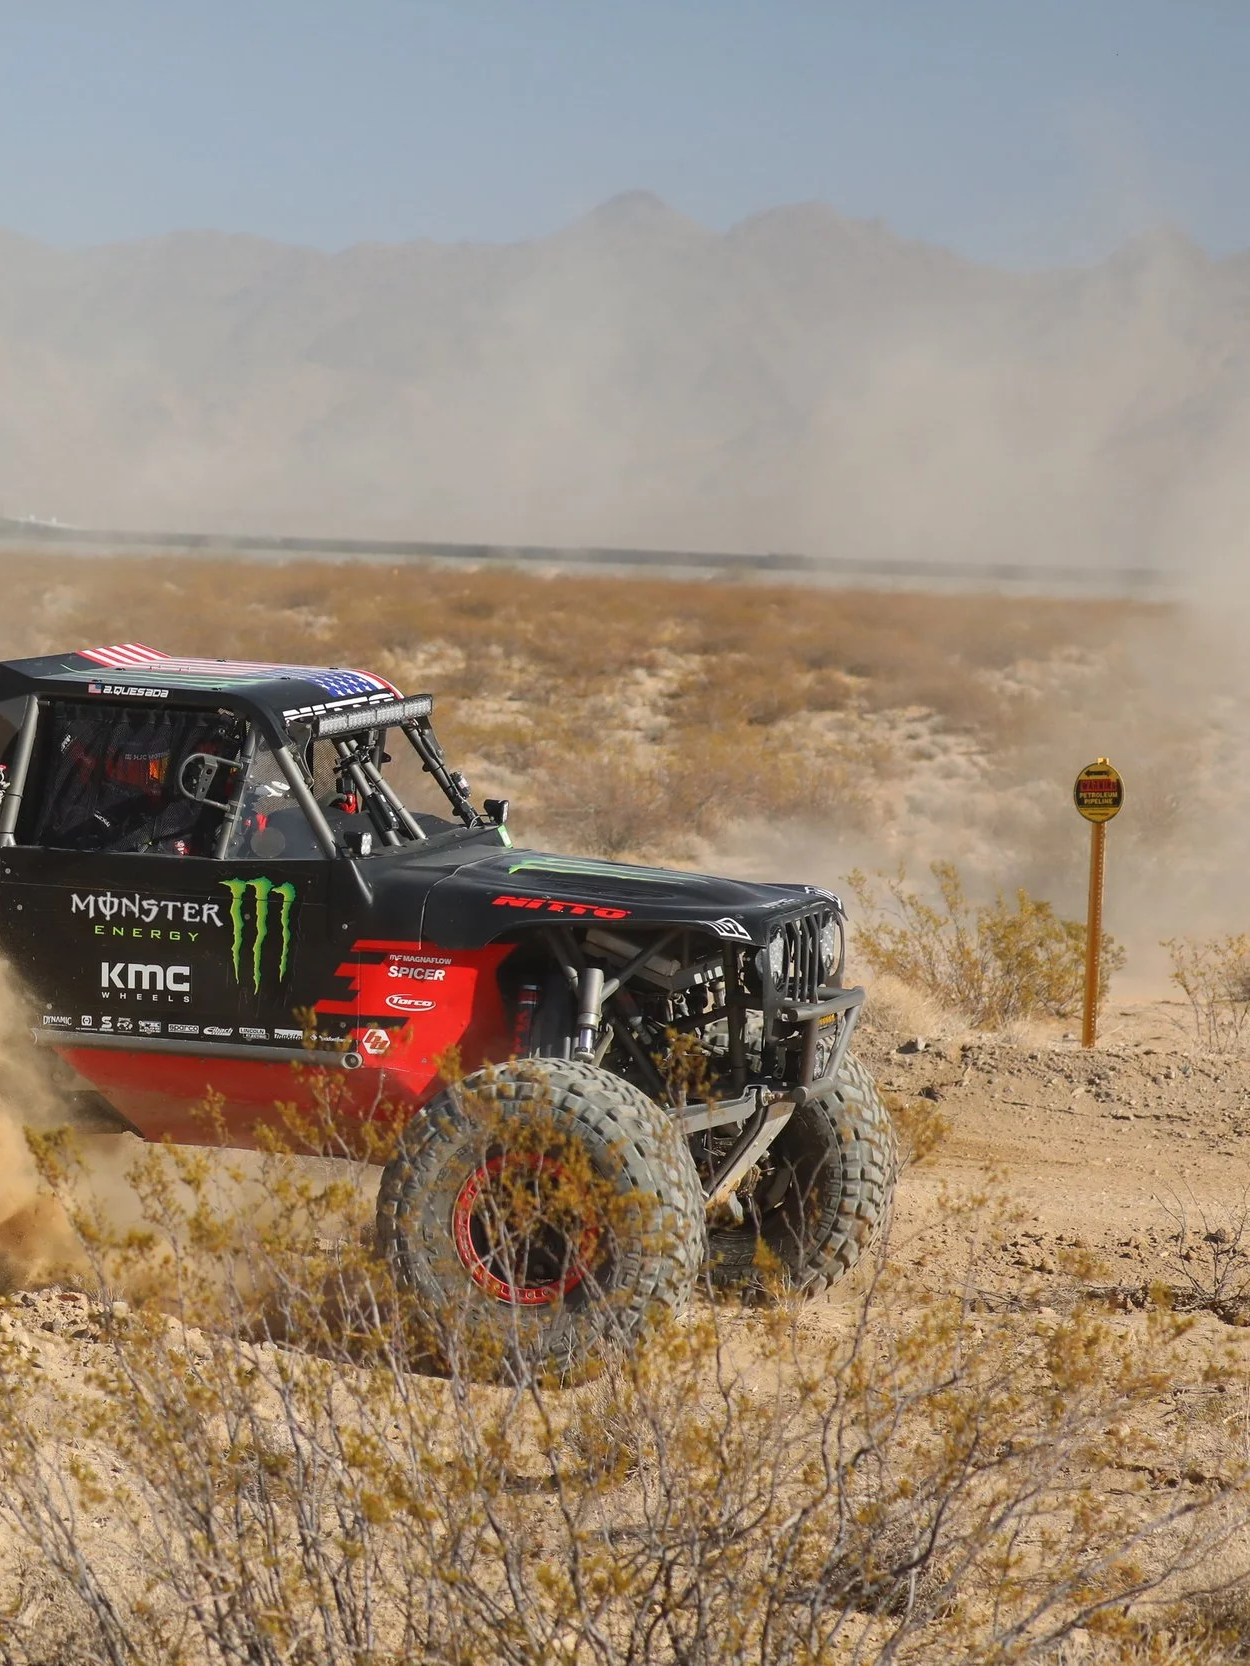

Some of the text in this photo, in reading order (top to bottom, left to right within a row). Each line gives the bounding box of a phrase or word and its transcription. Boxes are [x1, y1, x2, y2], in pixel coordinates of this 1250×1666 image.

[71, 891, 224, 927] MONSTER
[492, 895, 632, 919] NITTO
[94, 925, 199, 942] ENERGY
[402, 955, 452, 965] MAGNAFLOW
[387, 965, 446, 981] SPICER
[101, 991, 190, 1003] WHEELS
[391, 996, 433, 1007] Torco
[42, 1015, 72, 1026] DYNAMIC
